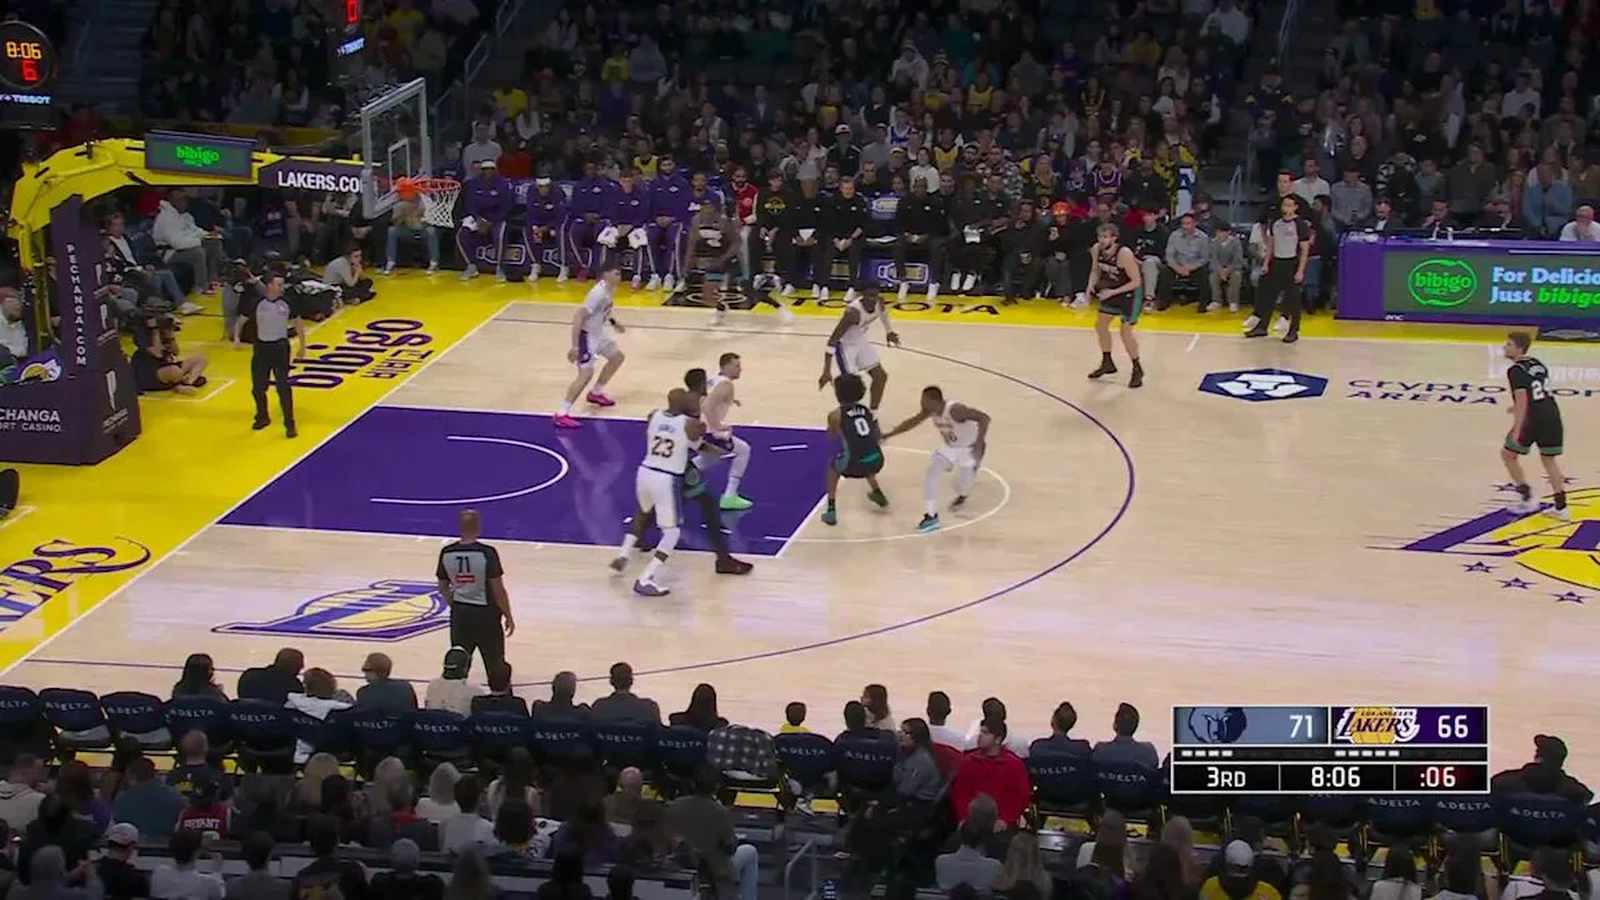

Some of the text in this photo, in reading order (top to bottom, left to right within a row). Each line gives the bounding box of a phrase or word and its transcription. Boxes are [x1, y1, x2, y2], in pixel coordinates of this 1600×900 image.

[6, 41, 42, 59] 8:06
[22, 60, 38, 80] 6
[277, 171, 363, 193] LAKERS.CO
[1415, 272, 1472, 292] bibigo
[1492, 266, 1527, 283] For
[1490, 287, 1532, 304] Just
[787, 296, 1000, 315] TOOTA
[1346, 391, 1499, 404] ARENA
[22, 422, 61, 433] CASINO
[854, 417, 870, 436] 0
[651, 435, 675, 458] 23
[455, 556, 471, 574] 71
[1380, 799, 1421, 808] DELTA
[1448, 800, 1491, 811] DELTA
[1521, 808, 1566, 818] DELTA
